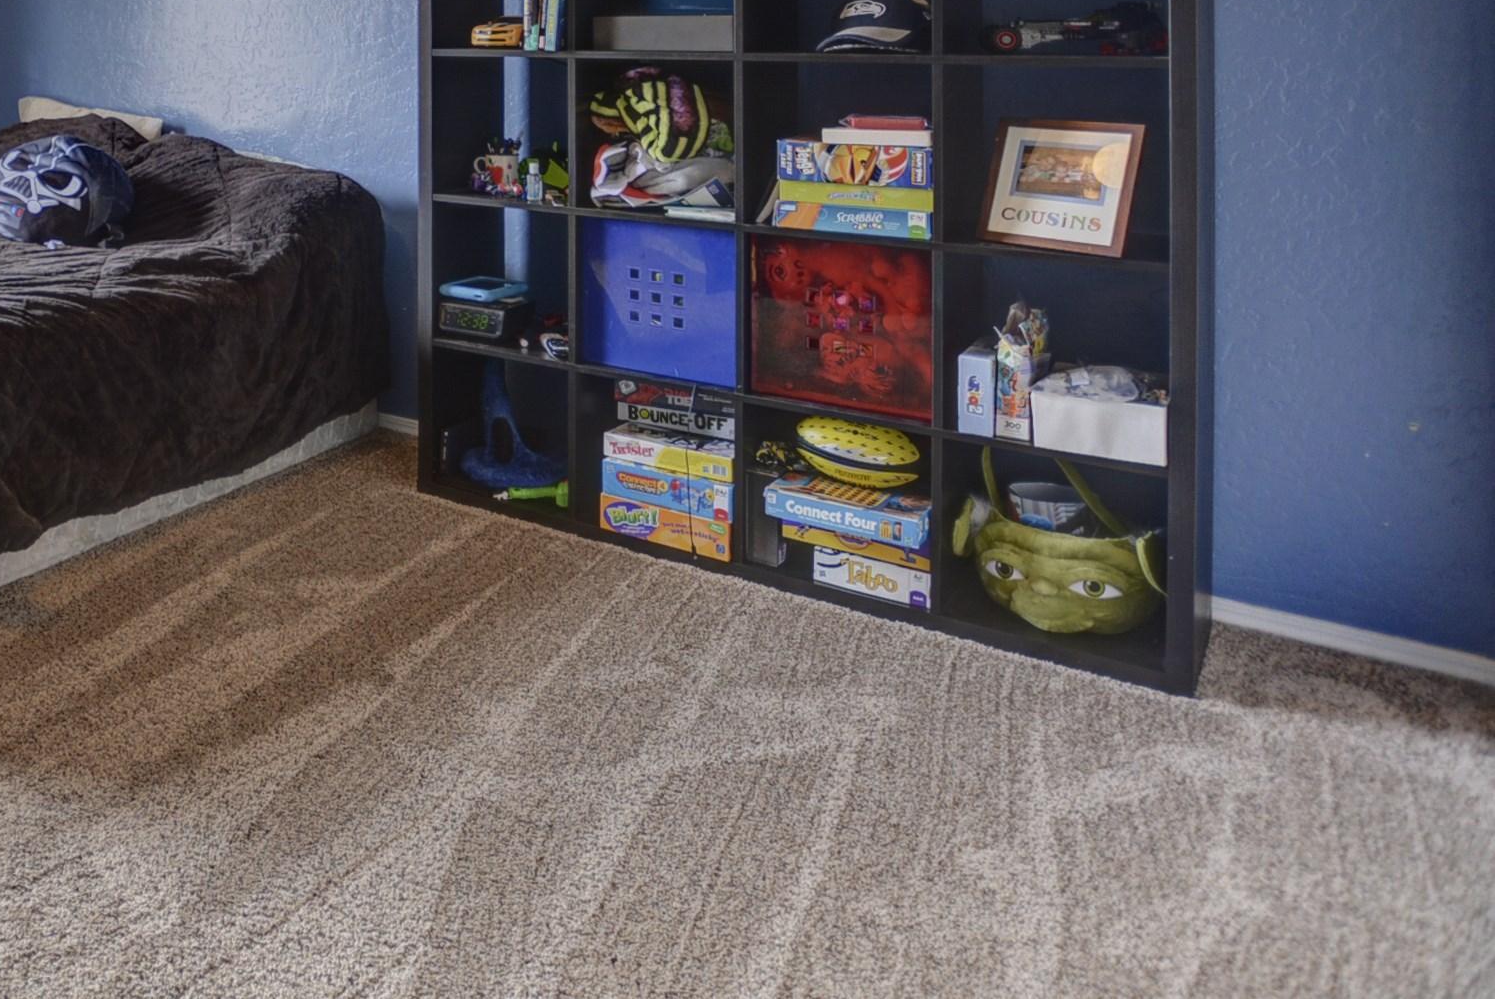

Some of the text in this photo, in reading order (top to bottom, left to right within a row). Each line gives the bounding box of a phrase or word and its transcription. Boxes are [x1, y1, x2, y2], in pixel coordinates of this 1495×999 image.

[457, 311, 489, 330] 12:38
[627, 405, 728, 431] BOUNCE-OFF
[609, 441, 655, 458] Twister
[606, 506, 659, 528] Blurt!
[785, 499, 878, 532] Connect Four
[844, 557, 899, 593] Taboo
